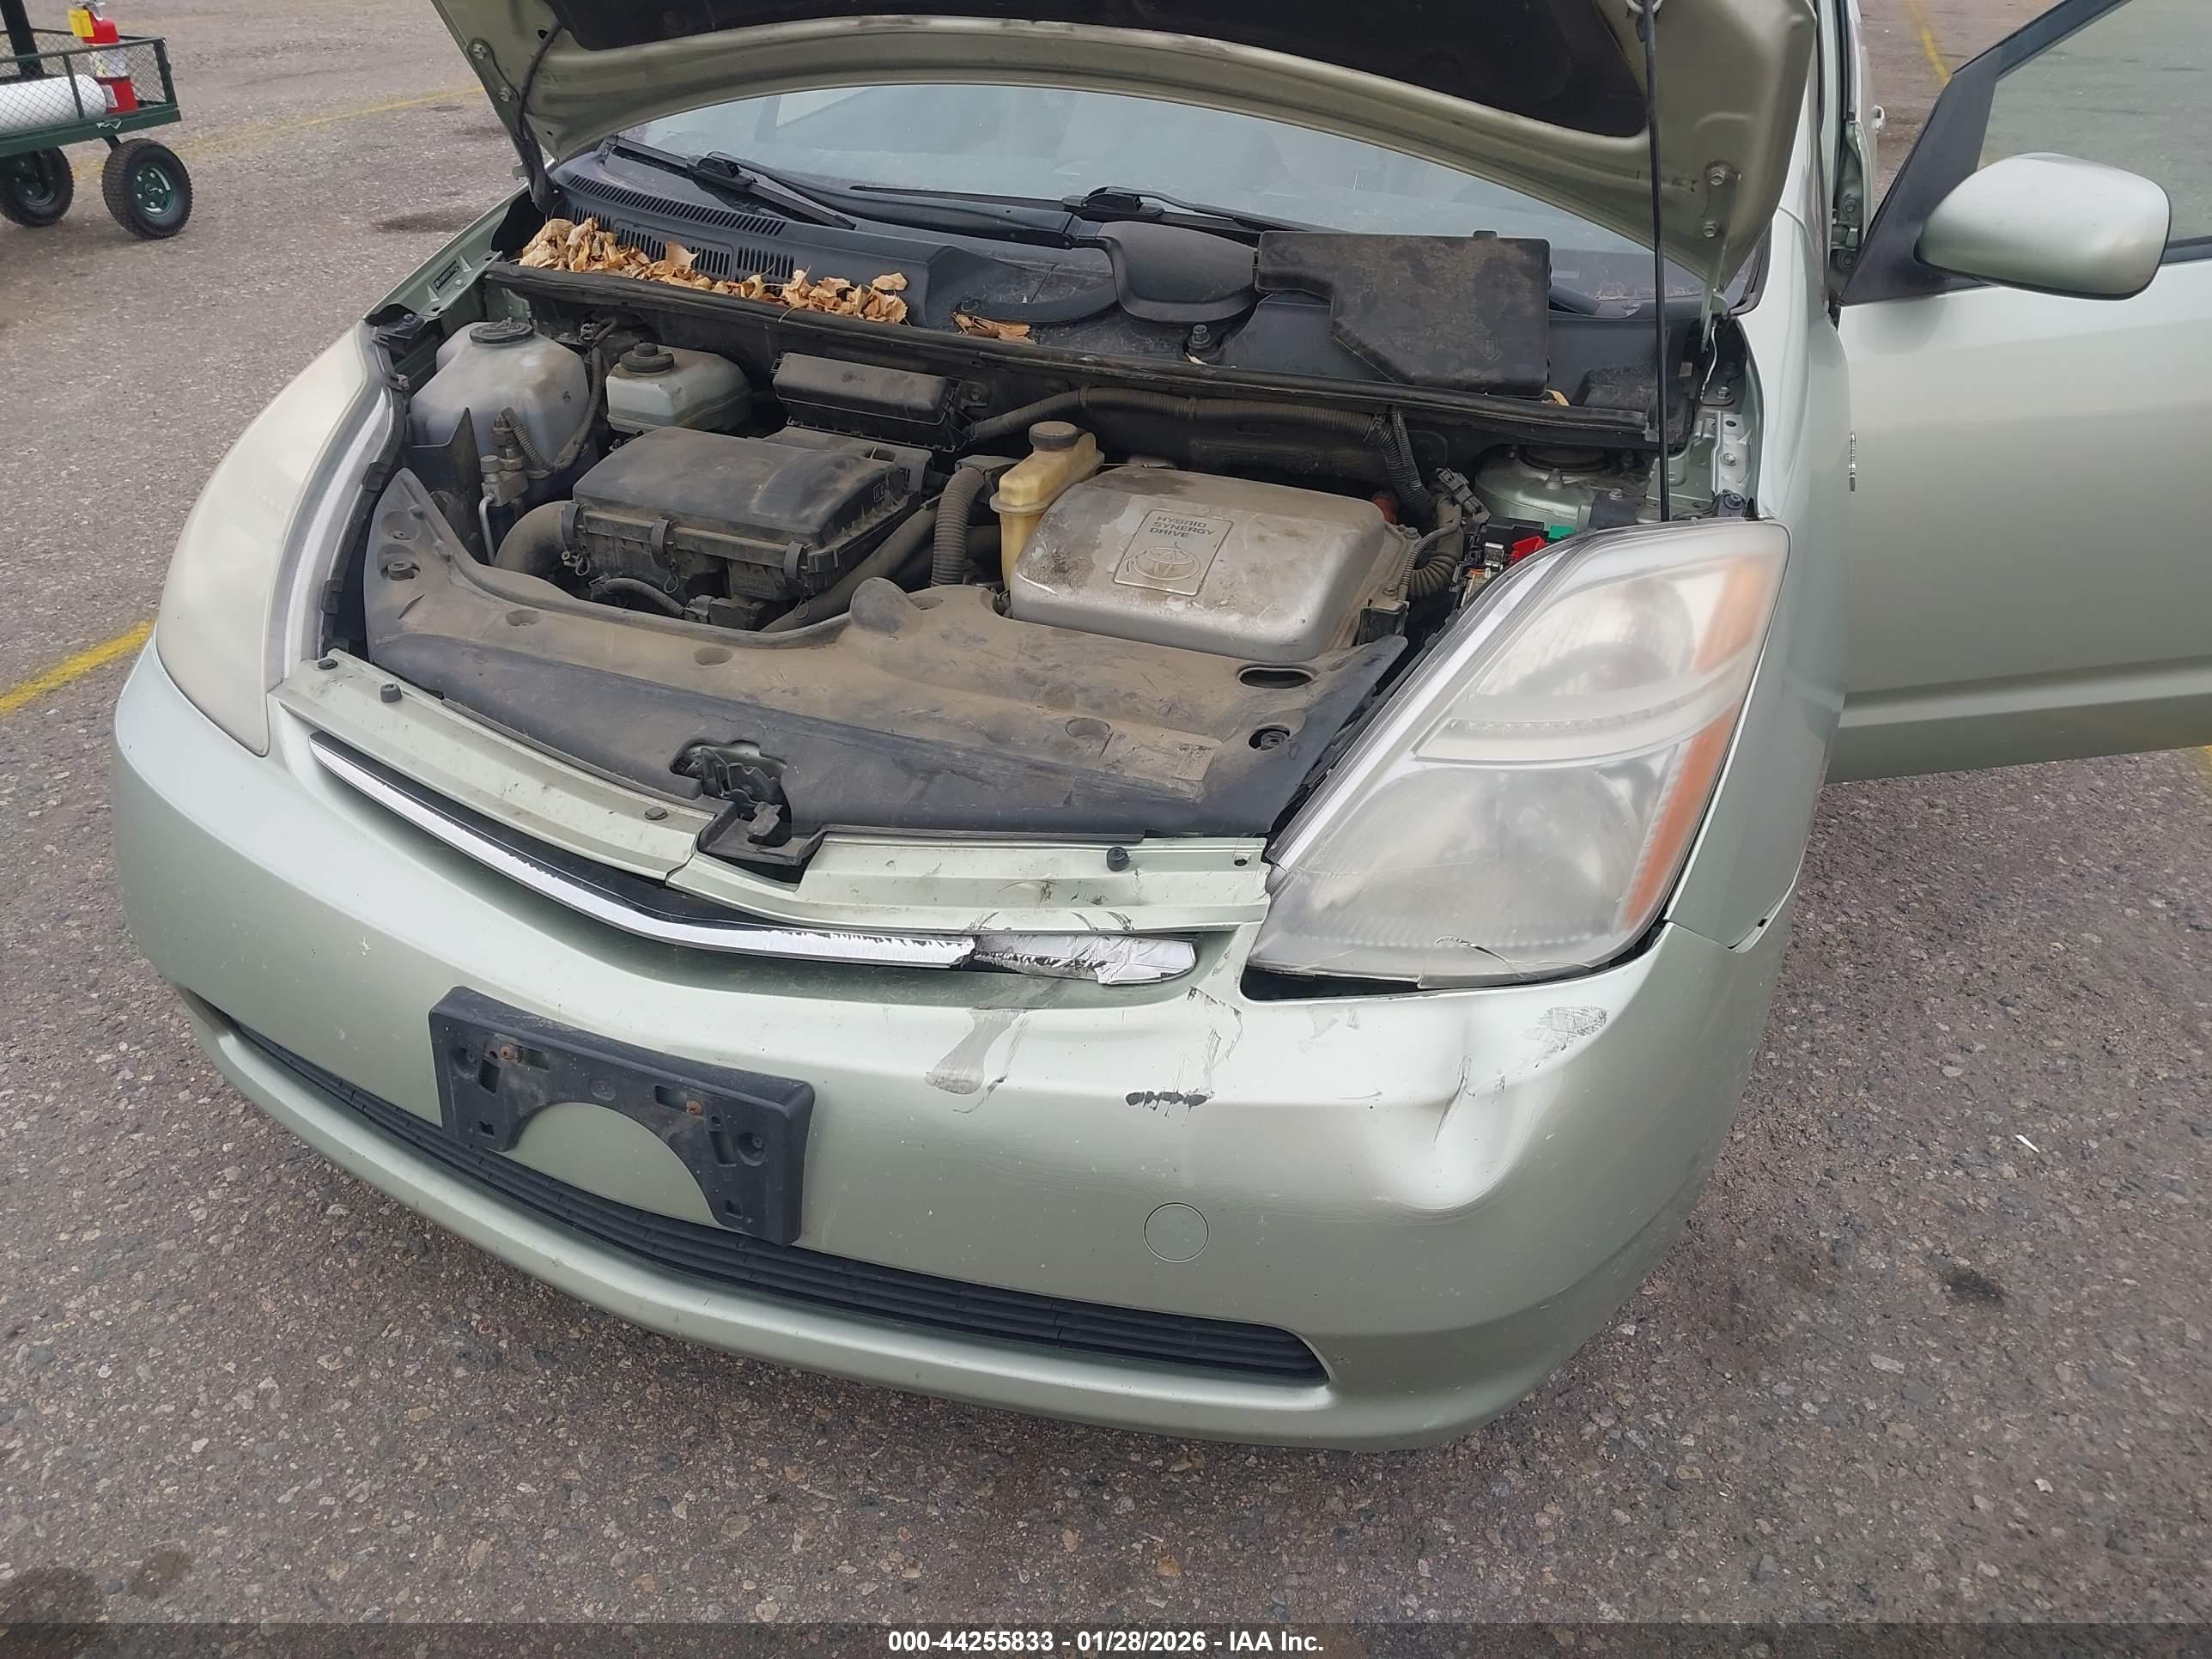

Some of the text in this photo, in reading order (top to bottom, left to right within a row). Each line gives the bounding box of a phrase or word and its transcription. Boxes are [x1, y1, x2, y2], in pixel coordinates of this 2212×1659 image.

[1156, 515, 1207, 528] HYBRID
[1149, 527, 1191, 538] DRIVE
[1152, 521, 1216, 536] SYNERGY
